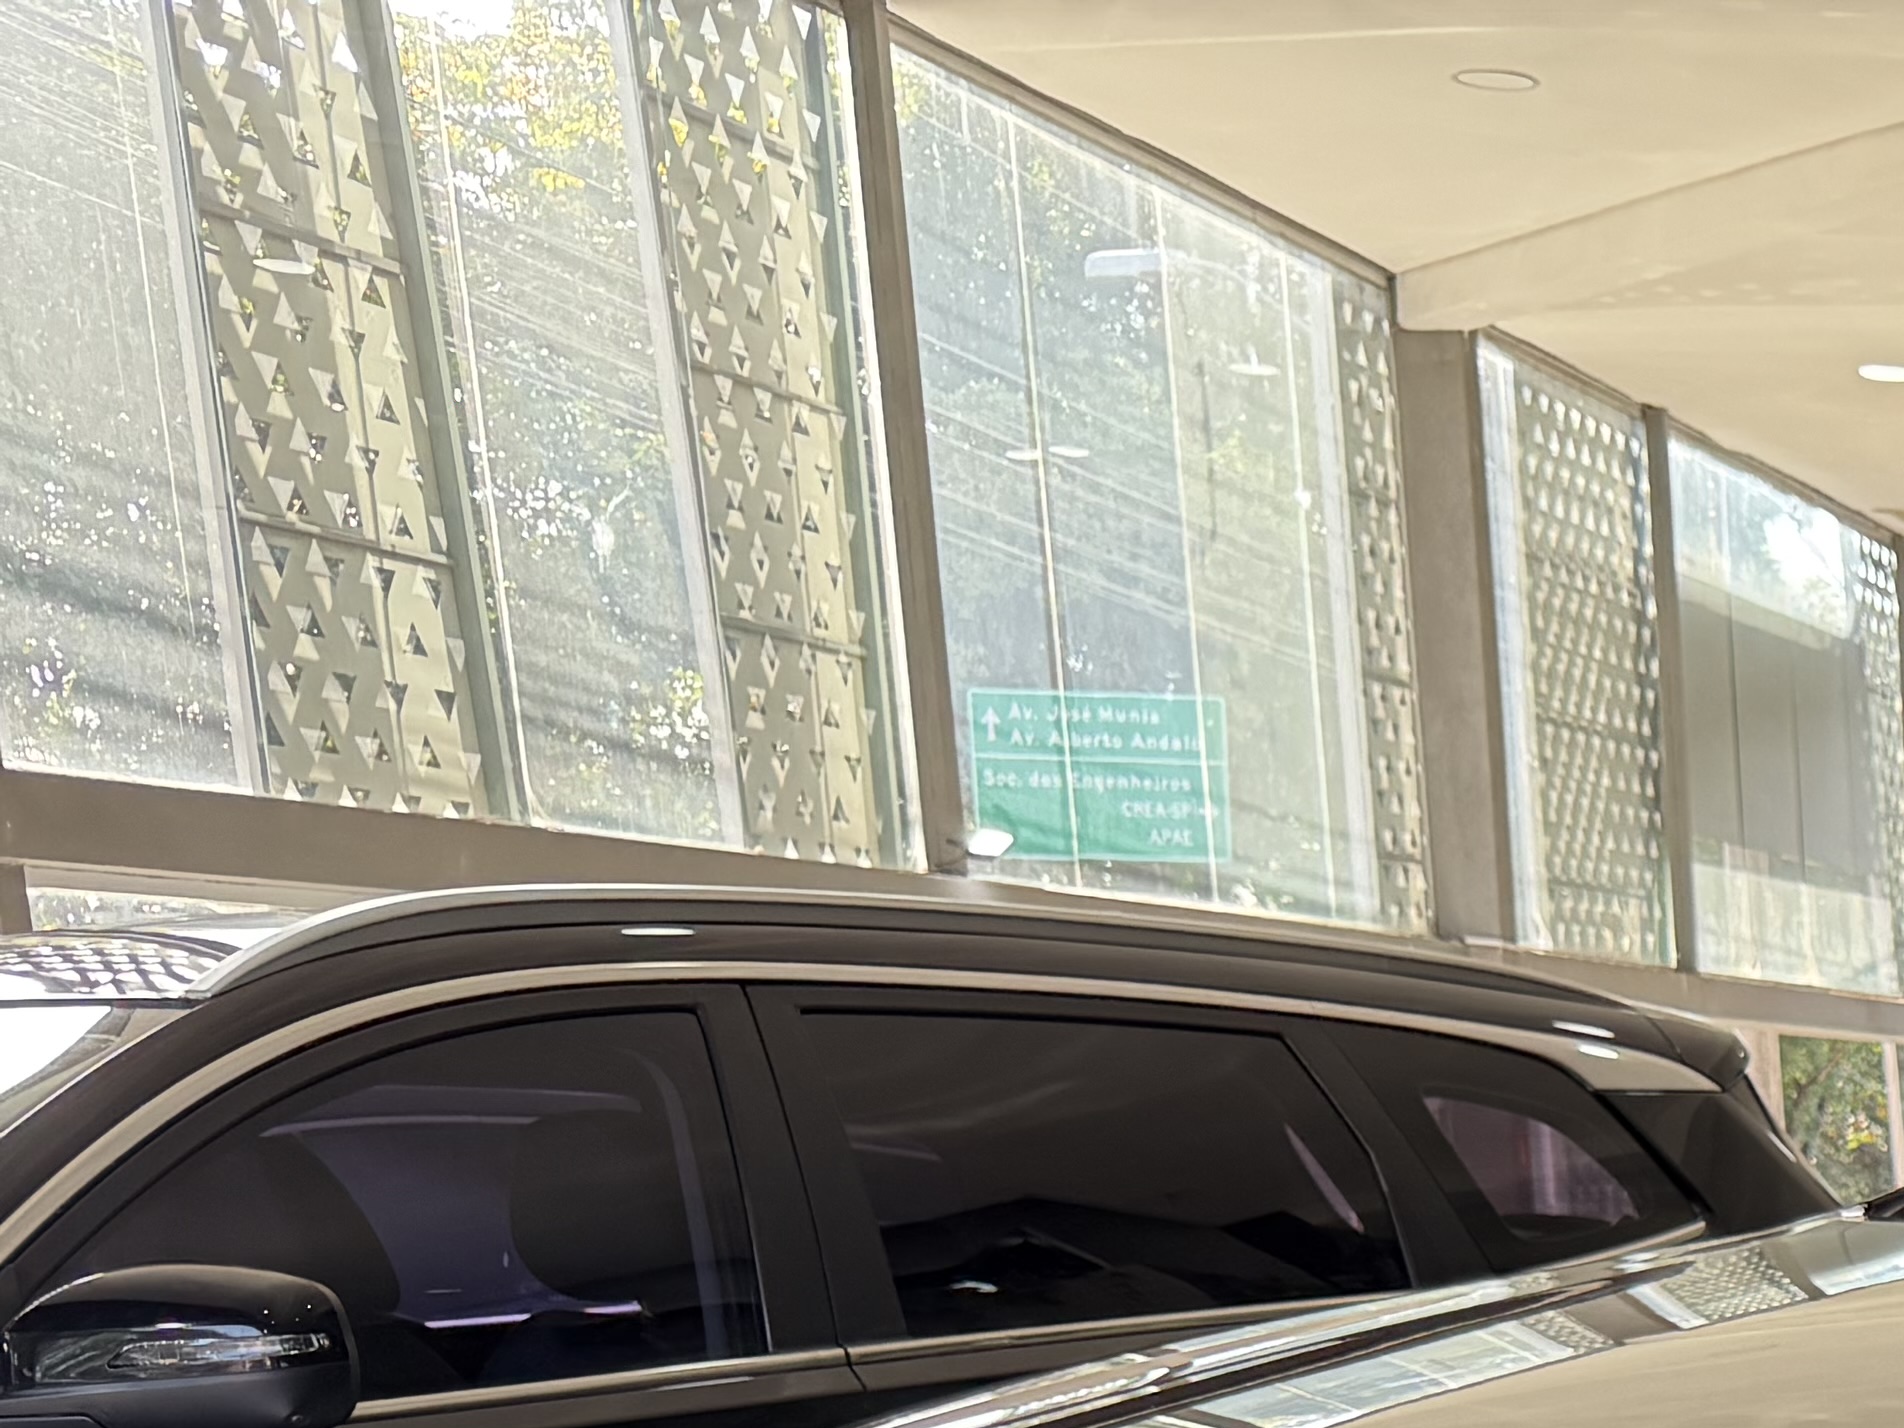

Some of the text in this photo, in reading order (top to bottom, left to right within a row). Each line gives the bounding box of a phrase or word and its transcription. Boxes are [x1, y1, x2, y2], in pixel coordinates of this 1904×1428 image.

[1008, 701, 1038, 721] Av.
[1046, 704, 1091, 722] Jsé
[1010, 727, 1040, 747] Av.
[1048, 729, 1123, 749] Aberto
[1149, 828, 1194, 847] APAE
